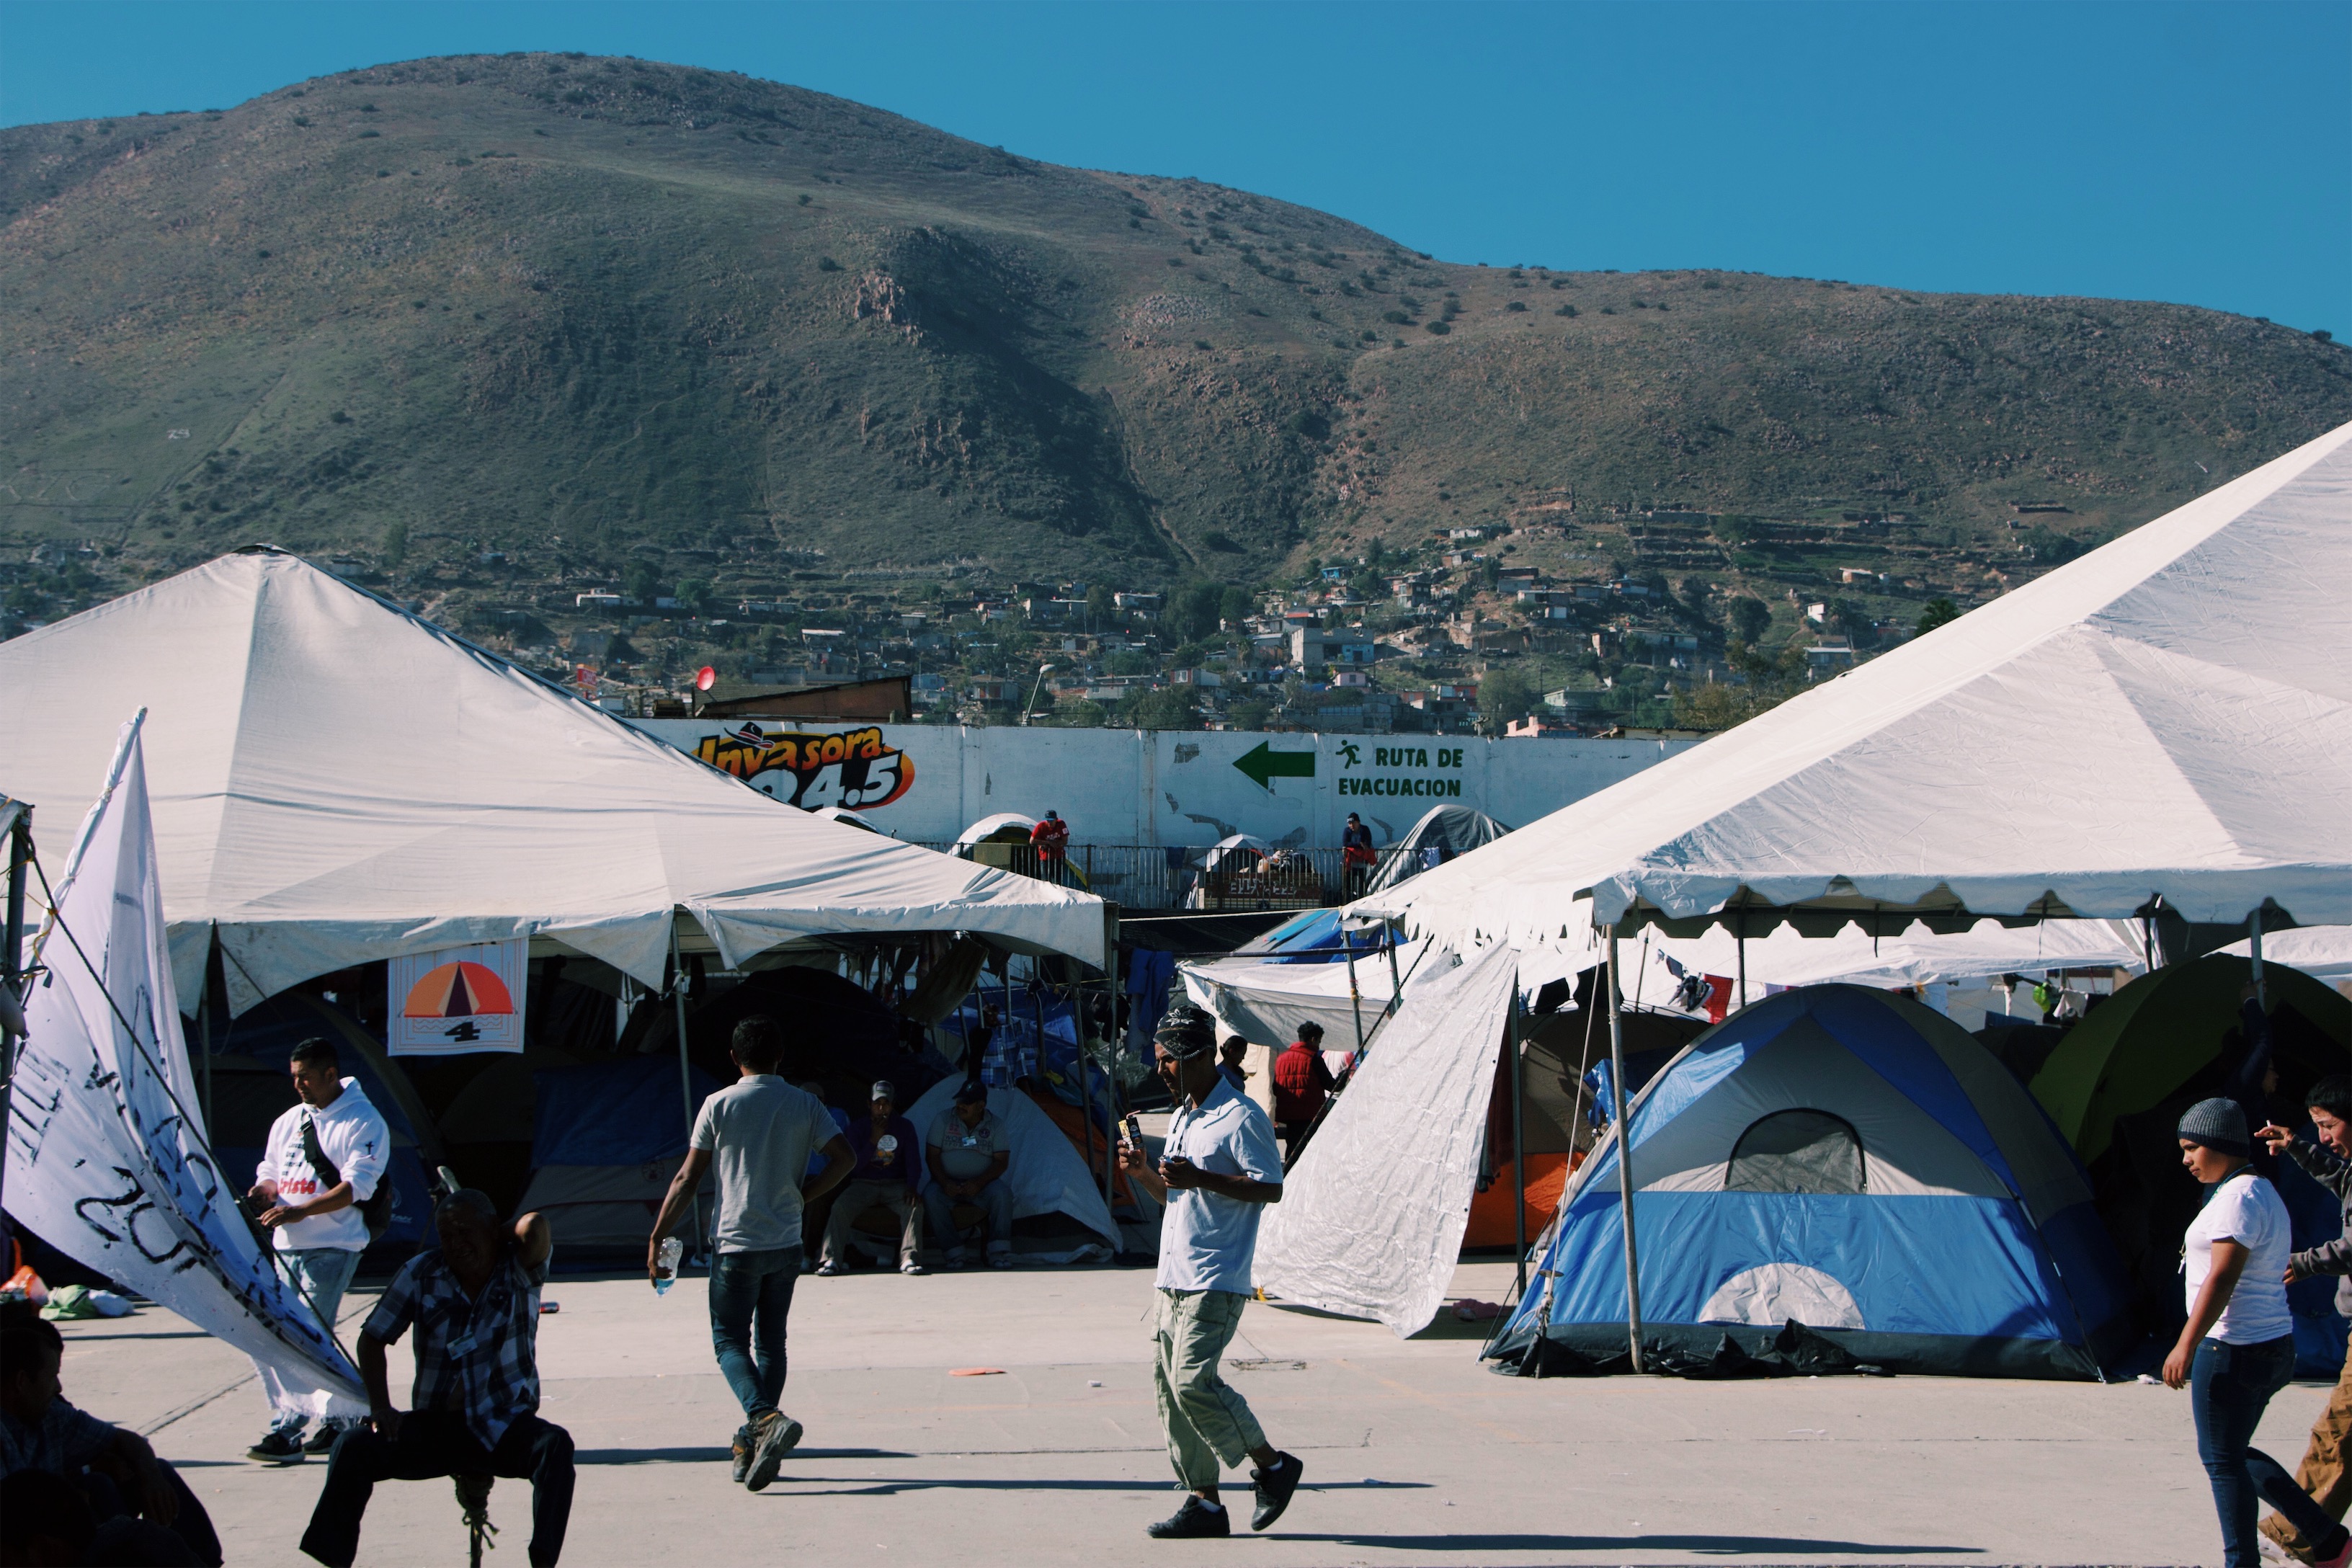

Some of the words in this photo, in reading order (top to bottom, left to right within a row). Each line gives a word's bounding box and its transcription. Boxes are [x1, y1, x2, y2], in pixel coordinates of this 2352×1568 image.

[1376, 748, 1428, 767] RUTA
[1438, 748, 1464, 768] DE
[1338, 778, 1461, 798] EVACUACION
[444, 1021, 481, 1042] 4
